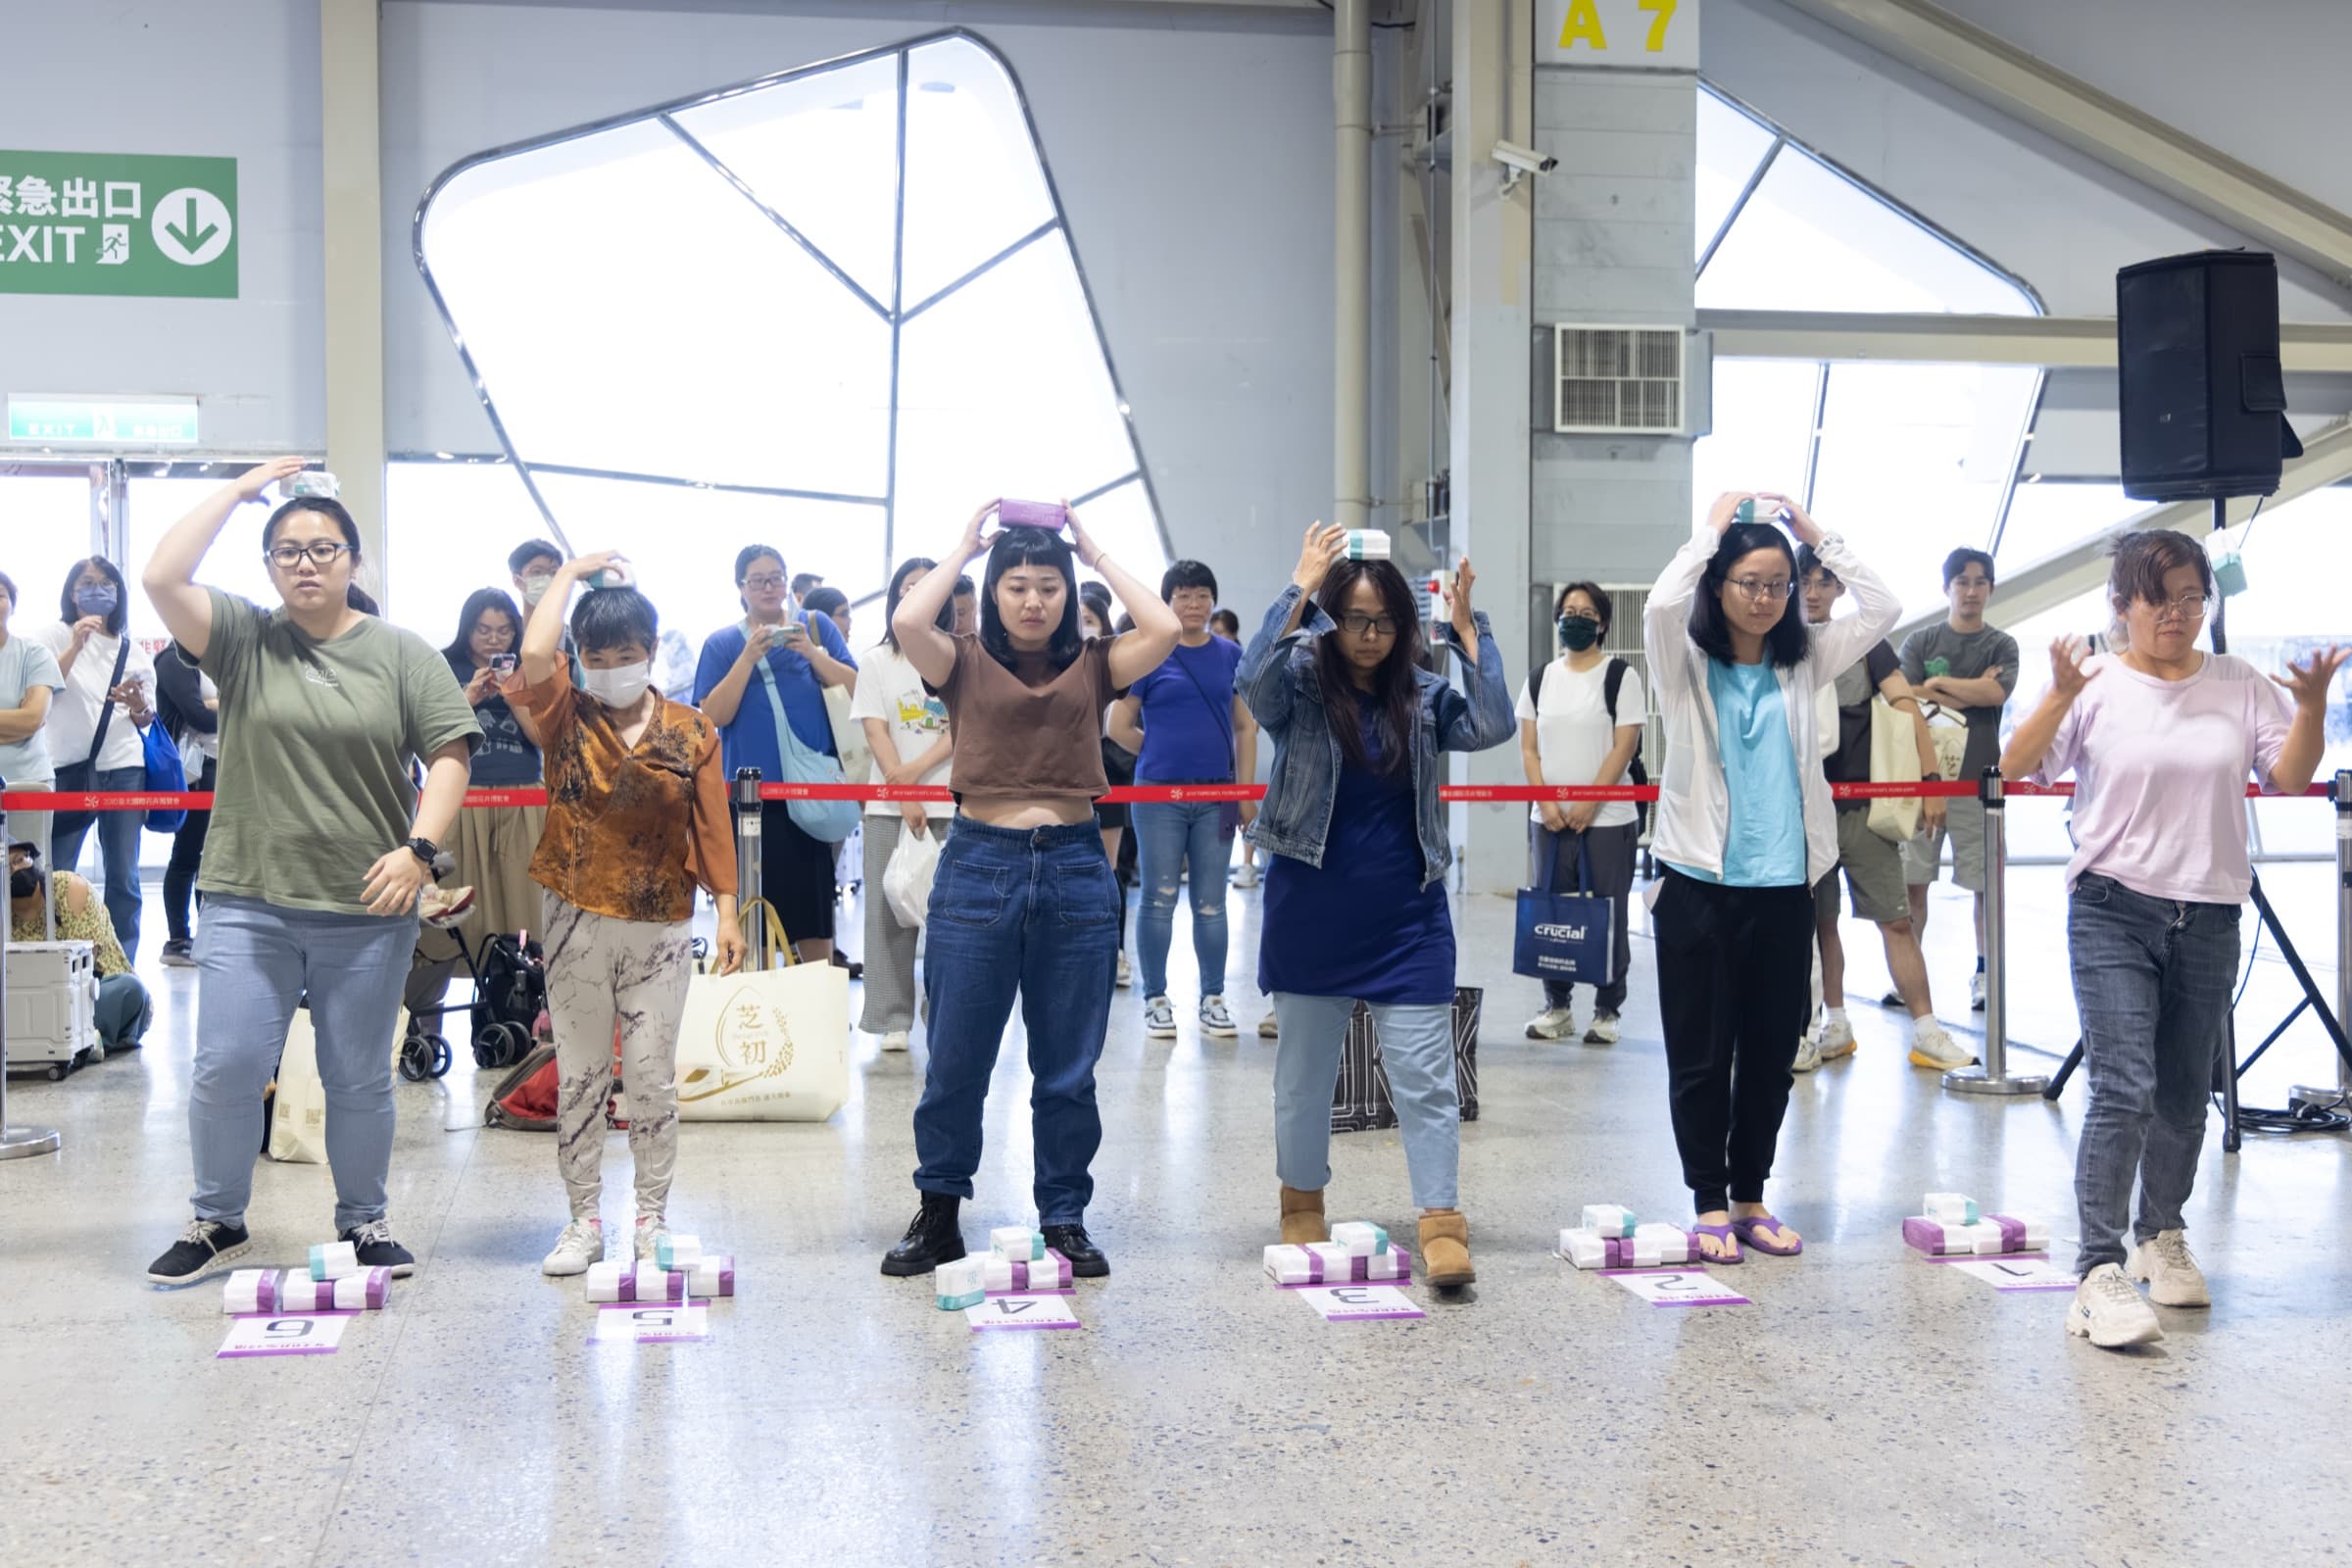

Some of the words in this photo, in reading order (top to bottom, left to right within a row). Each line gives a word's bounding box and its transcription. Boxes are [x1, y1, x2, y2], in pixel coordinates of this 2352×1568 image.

[1558, 0, 1608, 49] A
[1638, 0, 1678, 52] 7
[0, 224, 85, 264] XIT
[28, 422, 76, 436] EXIT
[1534, 923, 1585, 940] crucial
[991, 1298, 1038, 1314] 4
